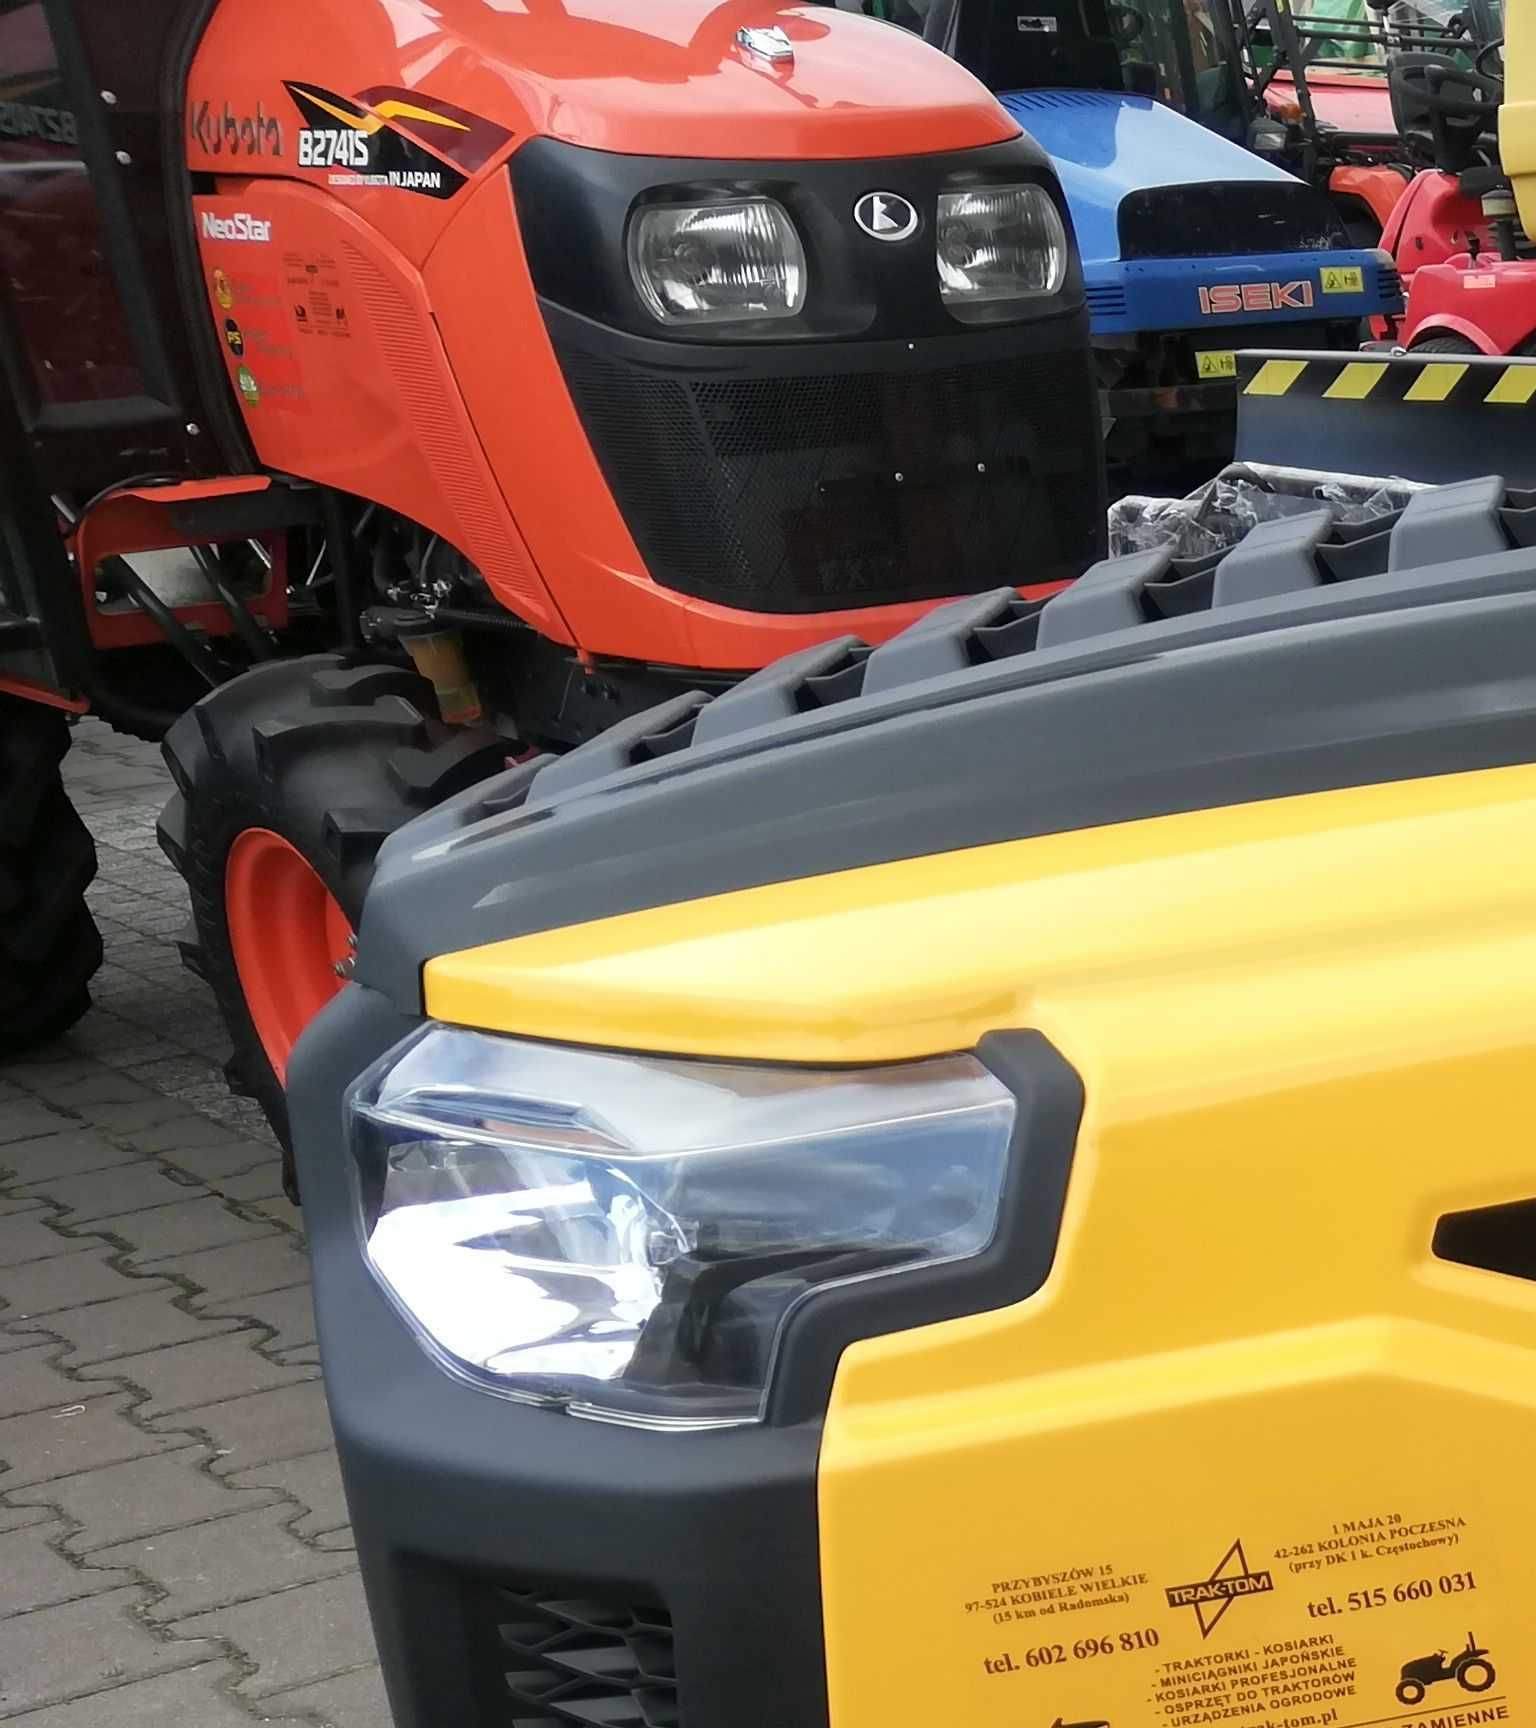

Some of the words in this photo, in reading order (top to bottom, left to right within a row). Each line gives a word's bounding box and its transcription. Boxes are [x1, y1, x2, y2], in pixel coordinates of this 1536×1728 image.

[191, 100, 285, 157] Kubota
[401, 172, 441, 188] JAPAN
[201, 212, 271, 242] NeoStar
[1198, 280, 1313, 314] ISEKI
[1274, 1542, 1313, 1560] 42-262
[1317, 1530, 1386, 1553] KOLONIA
[1389, 1517, 1467, 1542] POCZESNA
[1342, 1517, 1384, 1534] MAJA
[1386, 1513, 1402, 1526] 20
[1288, 1557, 1323, 1575] (przy
[1326, 1551, 1348, 1566] DK
[1375, 1532, 1460, 1558] Częstochowy)
[965, 1598, 1007, 1613] 97-524
[1011, 1583, 1078, 1607] KOBIELE
[1080, 1573, 1149, 1594] WIELKIE
[991, 1567, 1095, 1594] PRZYBYSZÓW
[1098, 1564, 1113, 1576] 15
[1169, 1575, 1270, 1604] TRAK-TOM
[1307, 1596, 1343, 1618] tel.
[1349, 1587, 1387, 1611] 515
[1393, 1579, 1433, 1602] 660
[1439, 1571, 1477, 1594] 031
[992, 1612, 1012, 1624] (15
[1014, 1608, 1036, 1621] km
[1039, 1603, 1056, 1617] od
[1059, 1592, 1130, 1613] Radomska)
[983, 1653, 1020, 1675] tel.
[1025, 1644, 1067, 1668] 602
[1073, 1634, 1114, 1660] 696
[1119, 1627, 1160, 1652] 810
[1160, 1662, 1259, 1688] MINICIĄGNIKI
[1262, 1646, 1345, 1670] JAPOŃSKIE
[1162, 1649, 1250, 1674] TRAKTORKI
[1263, 1634, 1334, 1656] KOSIARKI
[1155, 1680, 1227, 1703] KOSIARKI
[1231, 1657, 1357, 1691] PROFESJONALNE
[1164, 1694, 1232, 1715] OSPRZĘT
[1236, 1690, 1258, 1702] DO
[1261, 1671, 1356, 1697] TRAKTORÓW
[1171, 1699, 1266, 1728] URZĄDZENIA
[1270, 1685, 1357, 1710] OGRODOWE
